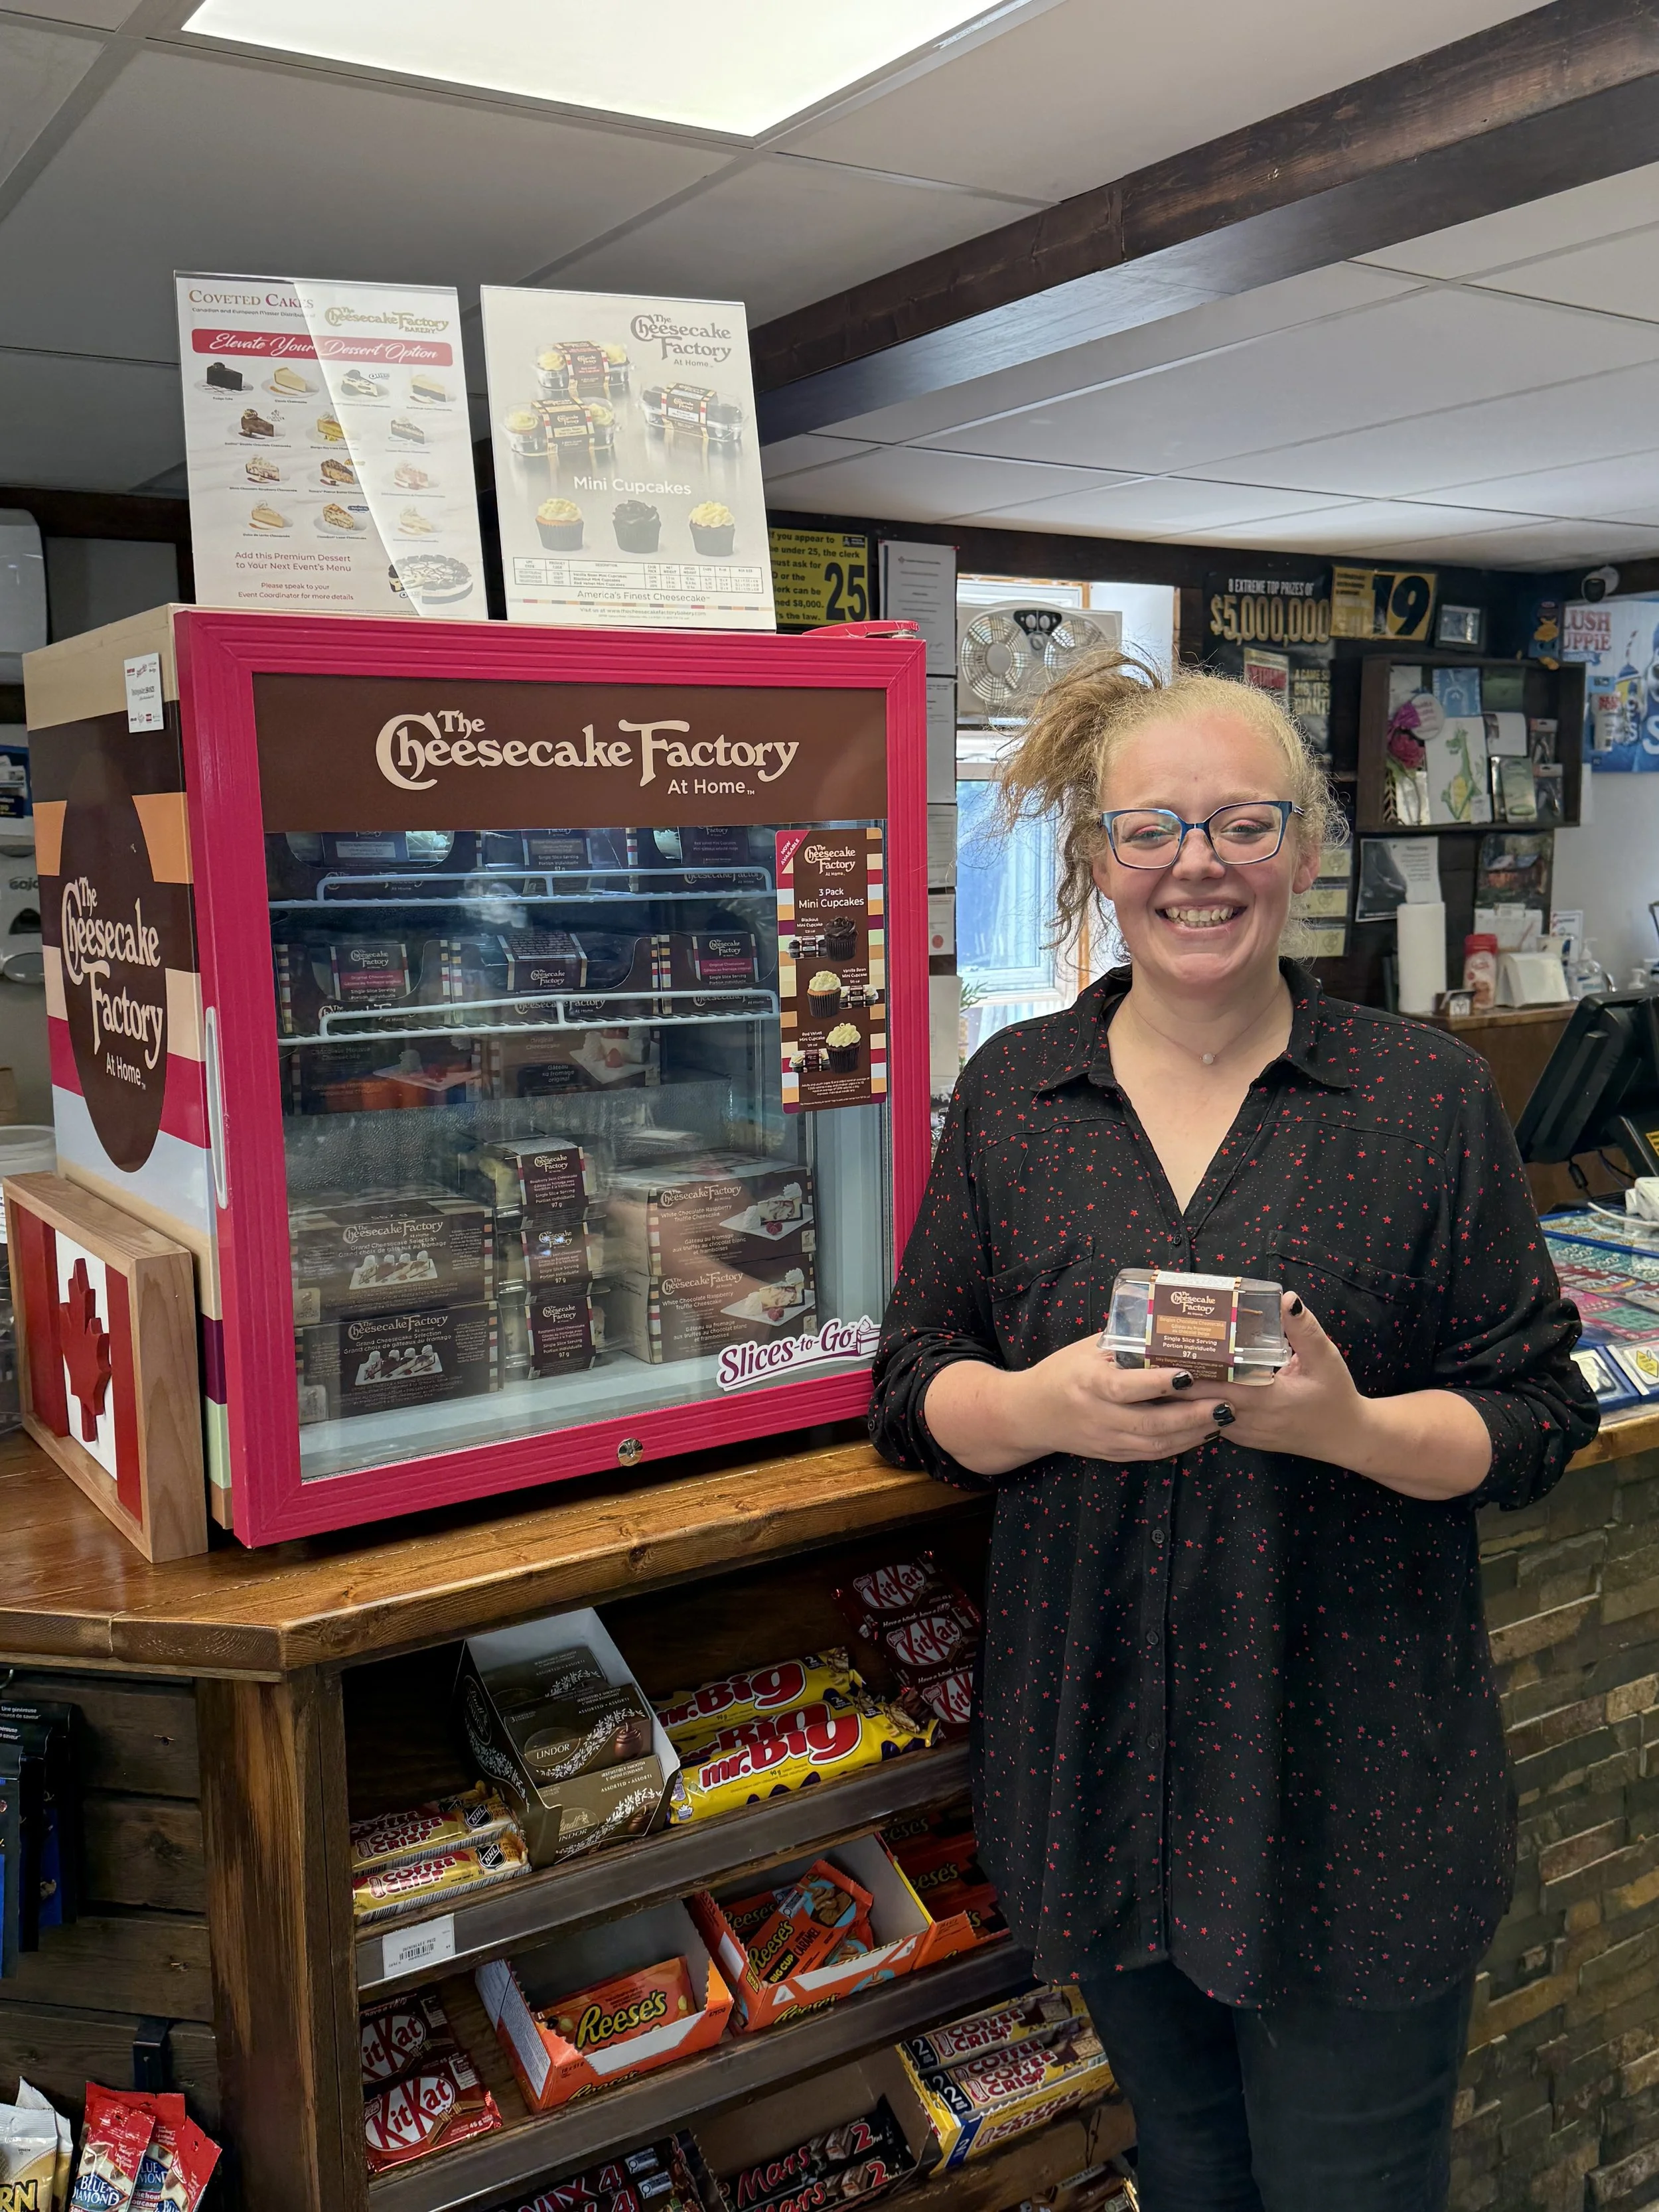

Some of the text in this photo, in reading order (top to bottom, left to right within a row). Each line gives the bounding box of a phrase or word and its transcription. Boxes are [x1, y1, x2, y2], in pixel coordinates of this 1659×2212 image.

[189, 289, 261, 305] COVETED
[325, 307, 449, 331] Cheesecake Factory
[630, 315, 731, 341] Cheesecake
[654, 314, 672, 324] The
[209, 332, 438, 364] Elevate Your Dessert Option
[652, 334, 731, 362] Factory
[573, 476, 691, 495] Mini Cupcakes
[794, 535, 824, 544] appear
[808, 548, 821, 557] 25,
[577, 590, 621, 599] America's
[824, 562, 867, 621] 25
[1235, 579, 1265, 594] EXTREME
[1267, 580, 1280, 595] TOP
[1281, 581, 1304, 595] PRIZES
[1305, 583, 1315, 596] OF
[793, 600, 824, 609] $8,000.
[1372, 575, 1430, 635] 19
[1210, 594, 1329, 648] $5,000,000
[1564, 609, 1611, 631] USH
[437, 709, 485, 739] The
[376, 711, 800, 790] Cheesecake Factory
[667, 778, 688, 794] At
[780, 840, 792, 855] NOW
[780, 838, 801, 865] AVAILABLE
[804, 845, 856, 863] Cheesecake
[816, 857, 856, 875] Factory
[78, 877, 98, 917] The
[798, 897, 865, 909] Mini Cupcakes
[826, 887, 844, 896] Pack
[62, 879, 161, 986] Cheesecake
[717, 946, 741, 956] Factory
[540, 977, 565, 986] Factory
[81, 955, 163, 1070] Factory
[106, 1052, 115, 1070] At
[660, 1185, 741, 1207] Cheesecake Factory
[342, 1220, 443, 1244] Cheesecake Factory
[662, 1272, 743, 1295] Cheesecake Factory
[1170, 1291, 1216, 1305] Cheesecake
[1182, 1301, 1215, 1315] Factory
[348, 1315, 448, 1341] Cheesecake Factory
[553, 1313, 576, 1323] Factory
[901, 1617, 958, 1664] KitKat
[536, 1743, 570, 1760] LINDOR
[601, 1781, 627, 1793] ASSORTED
[470, 1808, 485, 1822] NHL
[370, 1816, 443, 1845] COFFEE
[372, 1830, 431, 1854] CRISP
[484, 1846, 498, 1864] NHL
[382, 1856, 456, 1883] COFFEE
[384, 1869, 445, 1893] CRISP
[749, 1919, 794, 1976] Reese's
[770, 1954, 794, 1983] BIG CUP
[575, 1990, 667, 2049] Reese's
[948, 2008, 1026, 2038] COFFEE
[953, 2024, 1012, 2053] CRISP
[981, 2049, 1058, 2085] COFFEE
[987, 2067, 1046, 2097] CRISP
[372, 2075, 450, 2150] KitKat
[850, 2122, 873, 2154] 2
[80, 2175, 108, 2193] BLUE
[599, 2165, 621, 2193] 4
[737, 2145, 812, 2209] Mars
[866, 2160, 889, 2188] 2
